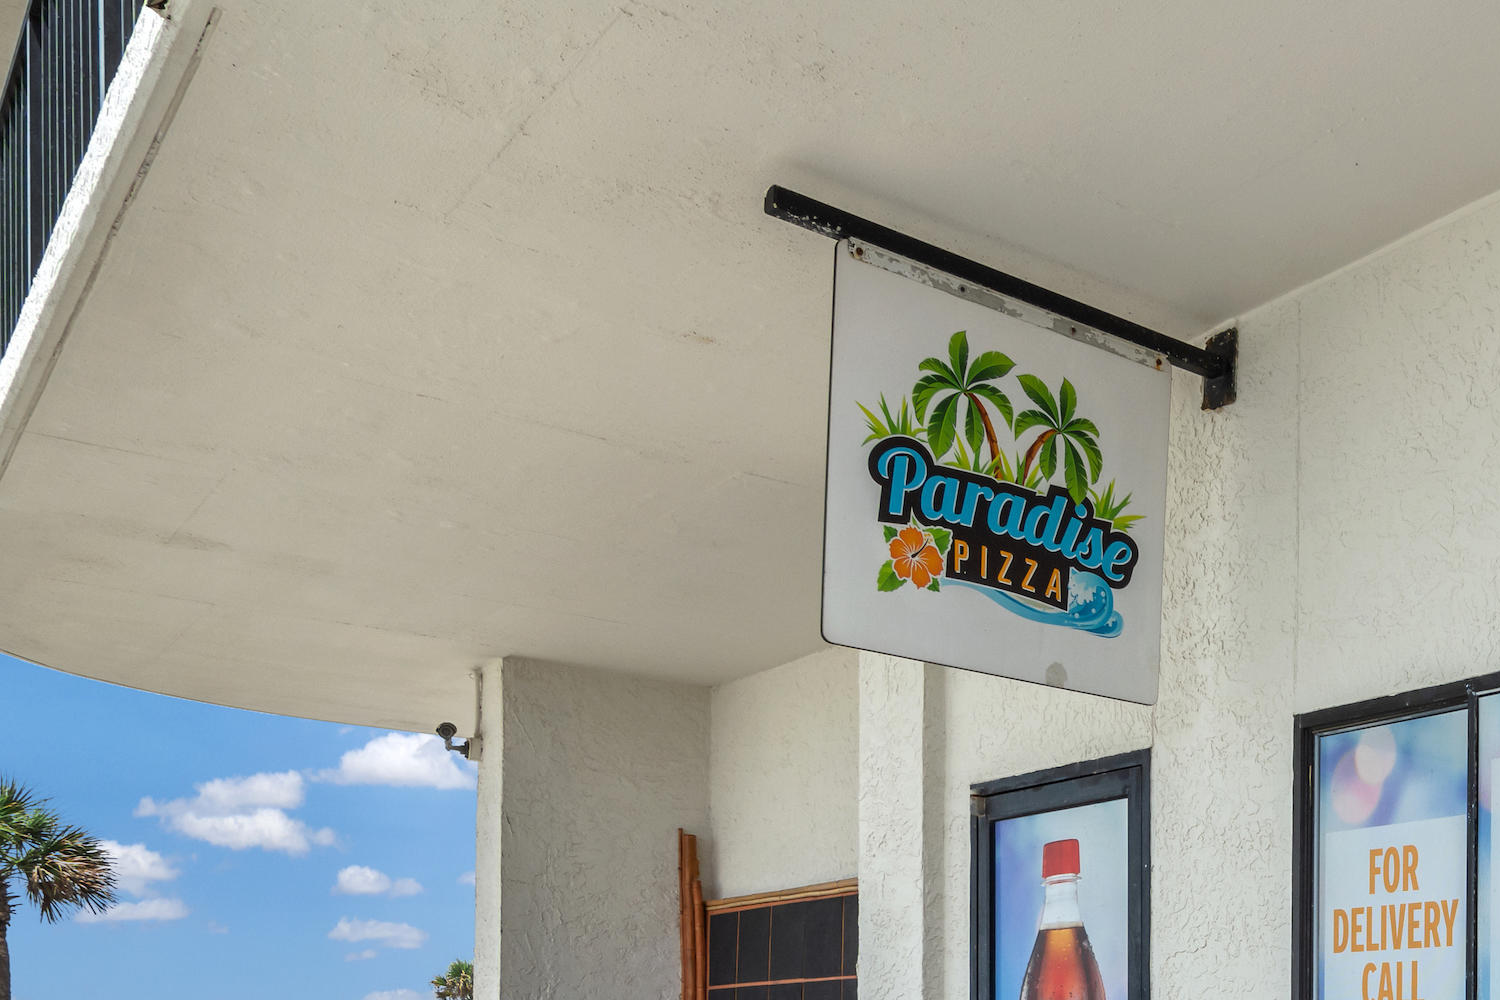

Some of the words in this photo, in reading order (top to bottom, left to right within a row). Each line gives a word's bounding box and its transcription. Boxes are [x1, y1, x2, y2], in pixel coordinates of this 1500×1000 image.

[878, 446, 1133, 581] Paradise
[954, 539, 1064, 602] PIZZA
[1369, 844, 1419, 894] FOR
[1333, 899, 1459, 953] DELIVERY
